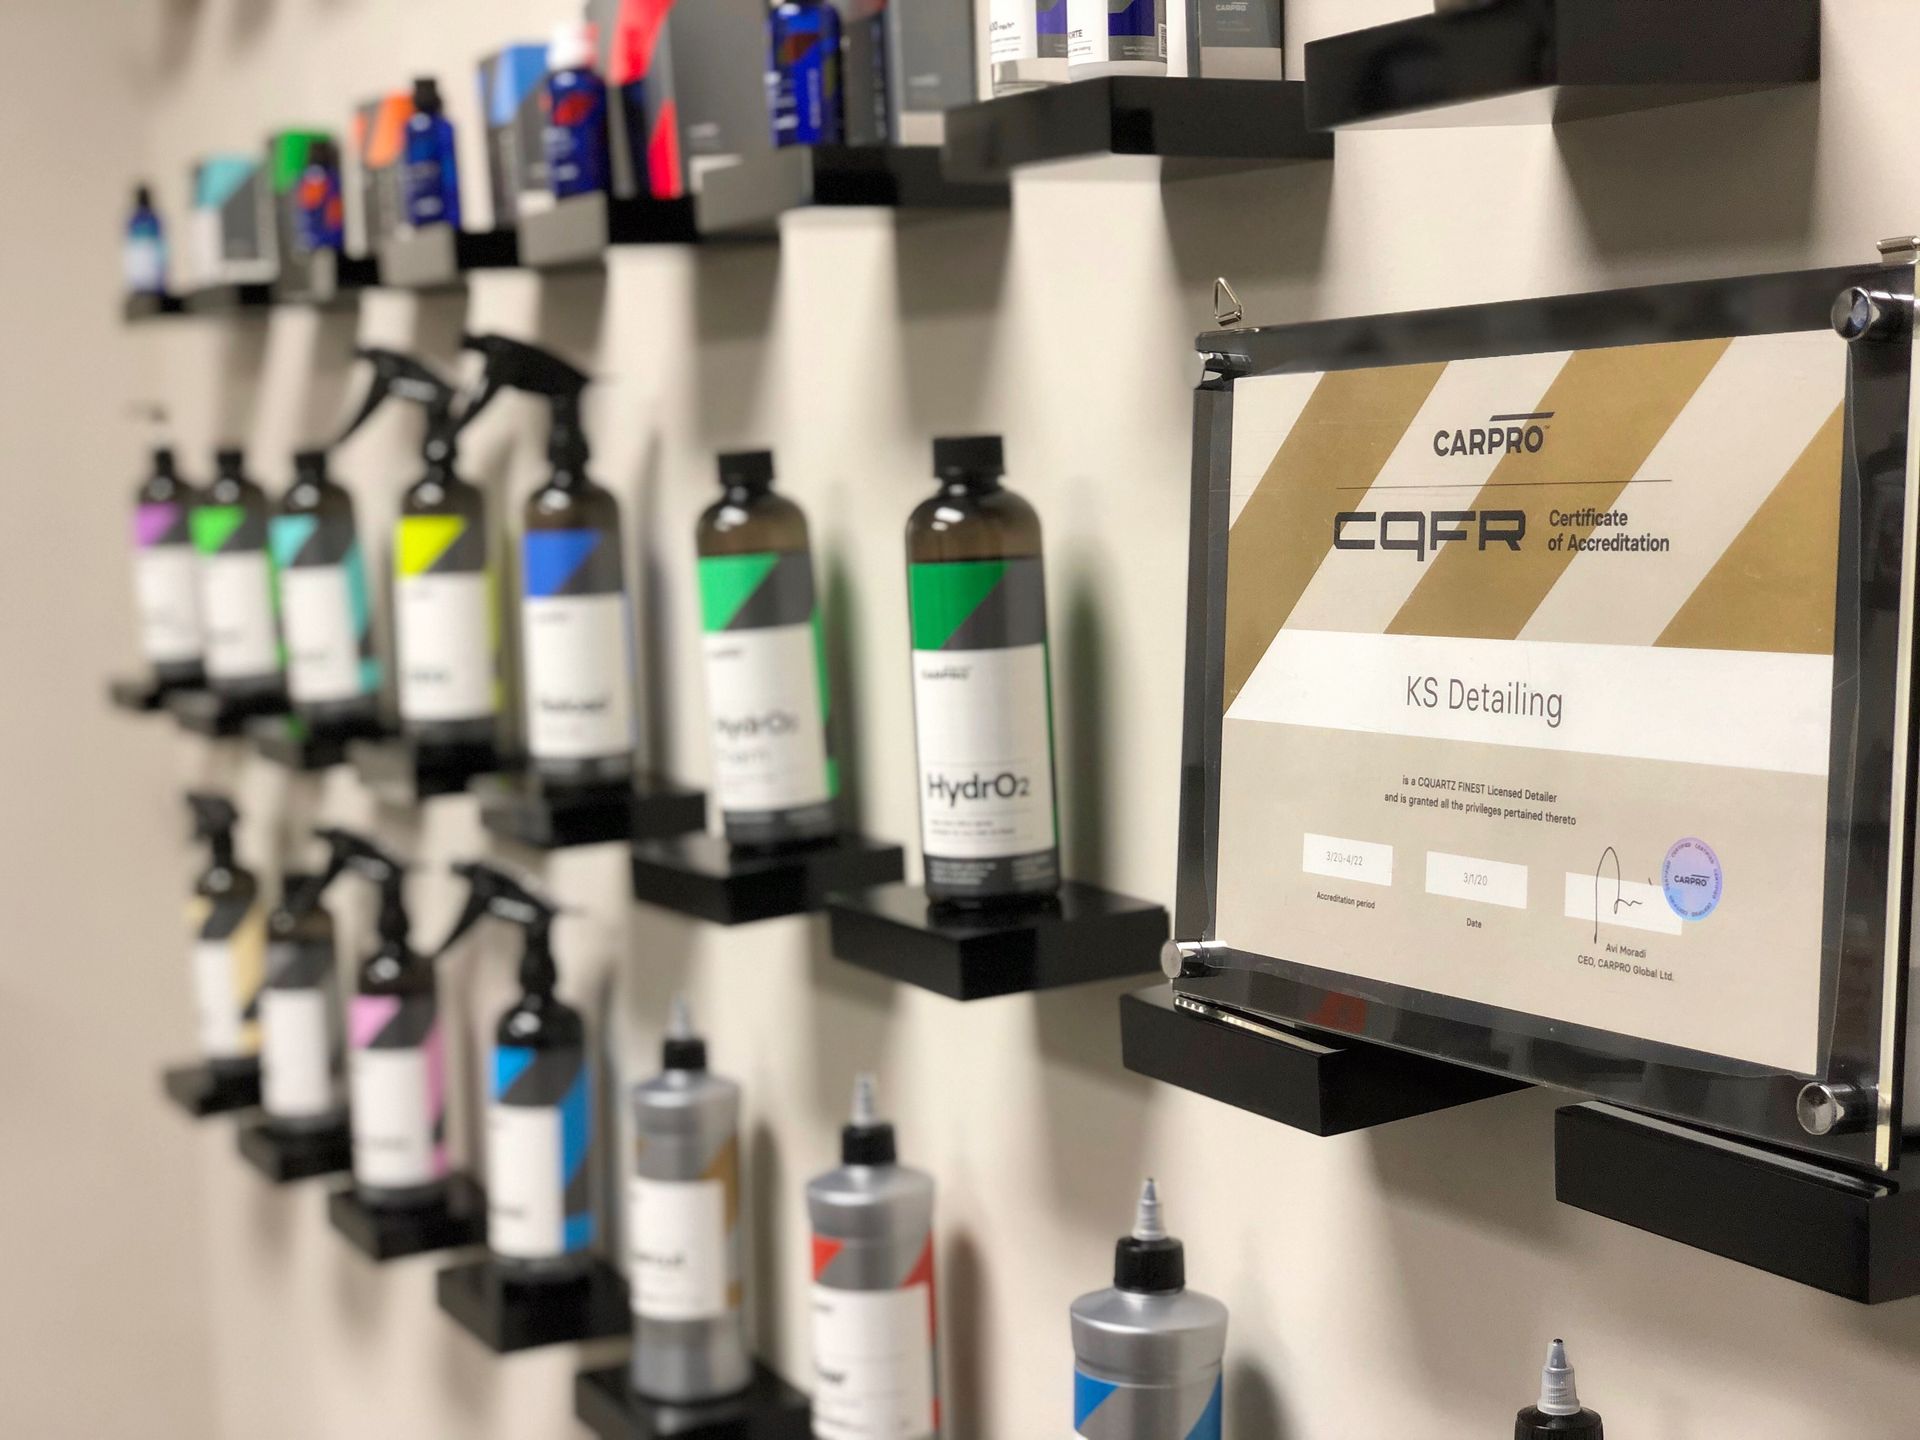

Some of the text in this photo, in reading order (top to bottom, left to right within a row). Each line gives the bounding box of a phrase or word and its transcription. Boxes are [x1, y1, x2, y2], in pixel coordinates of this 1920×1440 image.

[1433, 424, 1545, 457] CARPRO
[1549, 509, 1628, 527] Certificate
[1334, 510, 1526, 561] CQFR
[1548, 532, 1670, 552] of Accreditation
[1407, 675, 1562, 728] KS Detailing
[926, 772, 1030, 808] HydrO2
[1402, 774, 1557, 803] is a CQUARTZ FINEST Licensed Detailer
[1384, 792, 1576, 826] and is granted all the privileges pertained thereto
[1325, 850, 1363, 867] 3/20-4/22
[1463, 872, 1488, 887] 3/1/20
[1673, 875, 1708, 887] CARPRO
[1316, 891, 1376, 910] Accreditation period
[1466, 917, 1482, 929] Date
[1606, 943, 1647, 959] Avi Moradi
[1577, 954, 1675, 981] CEO, CARPRO Global Ltd.
